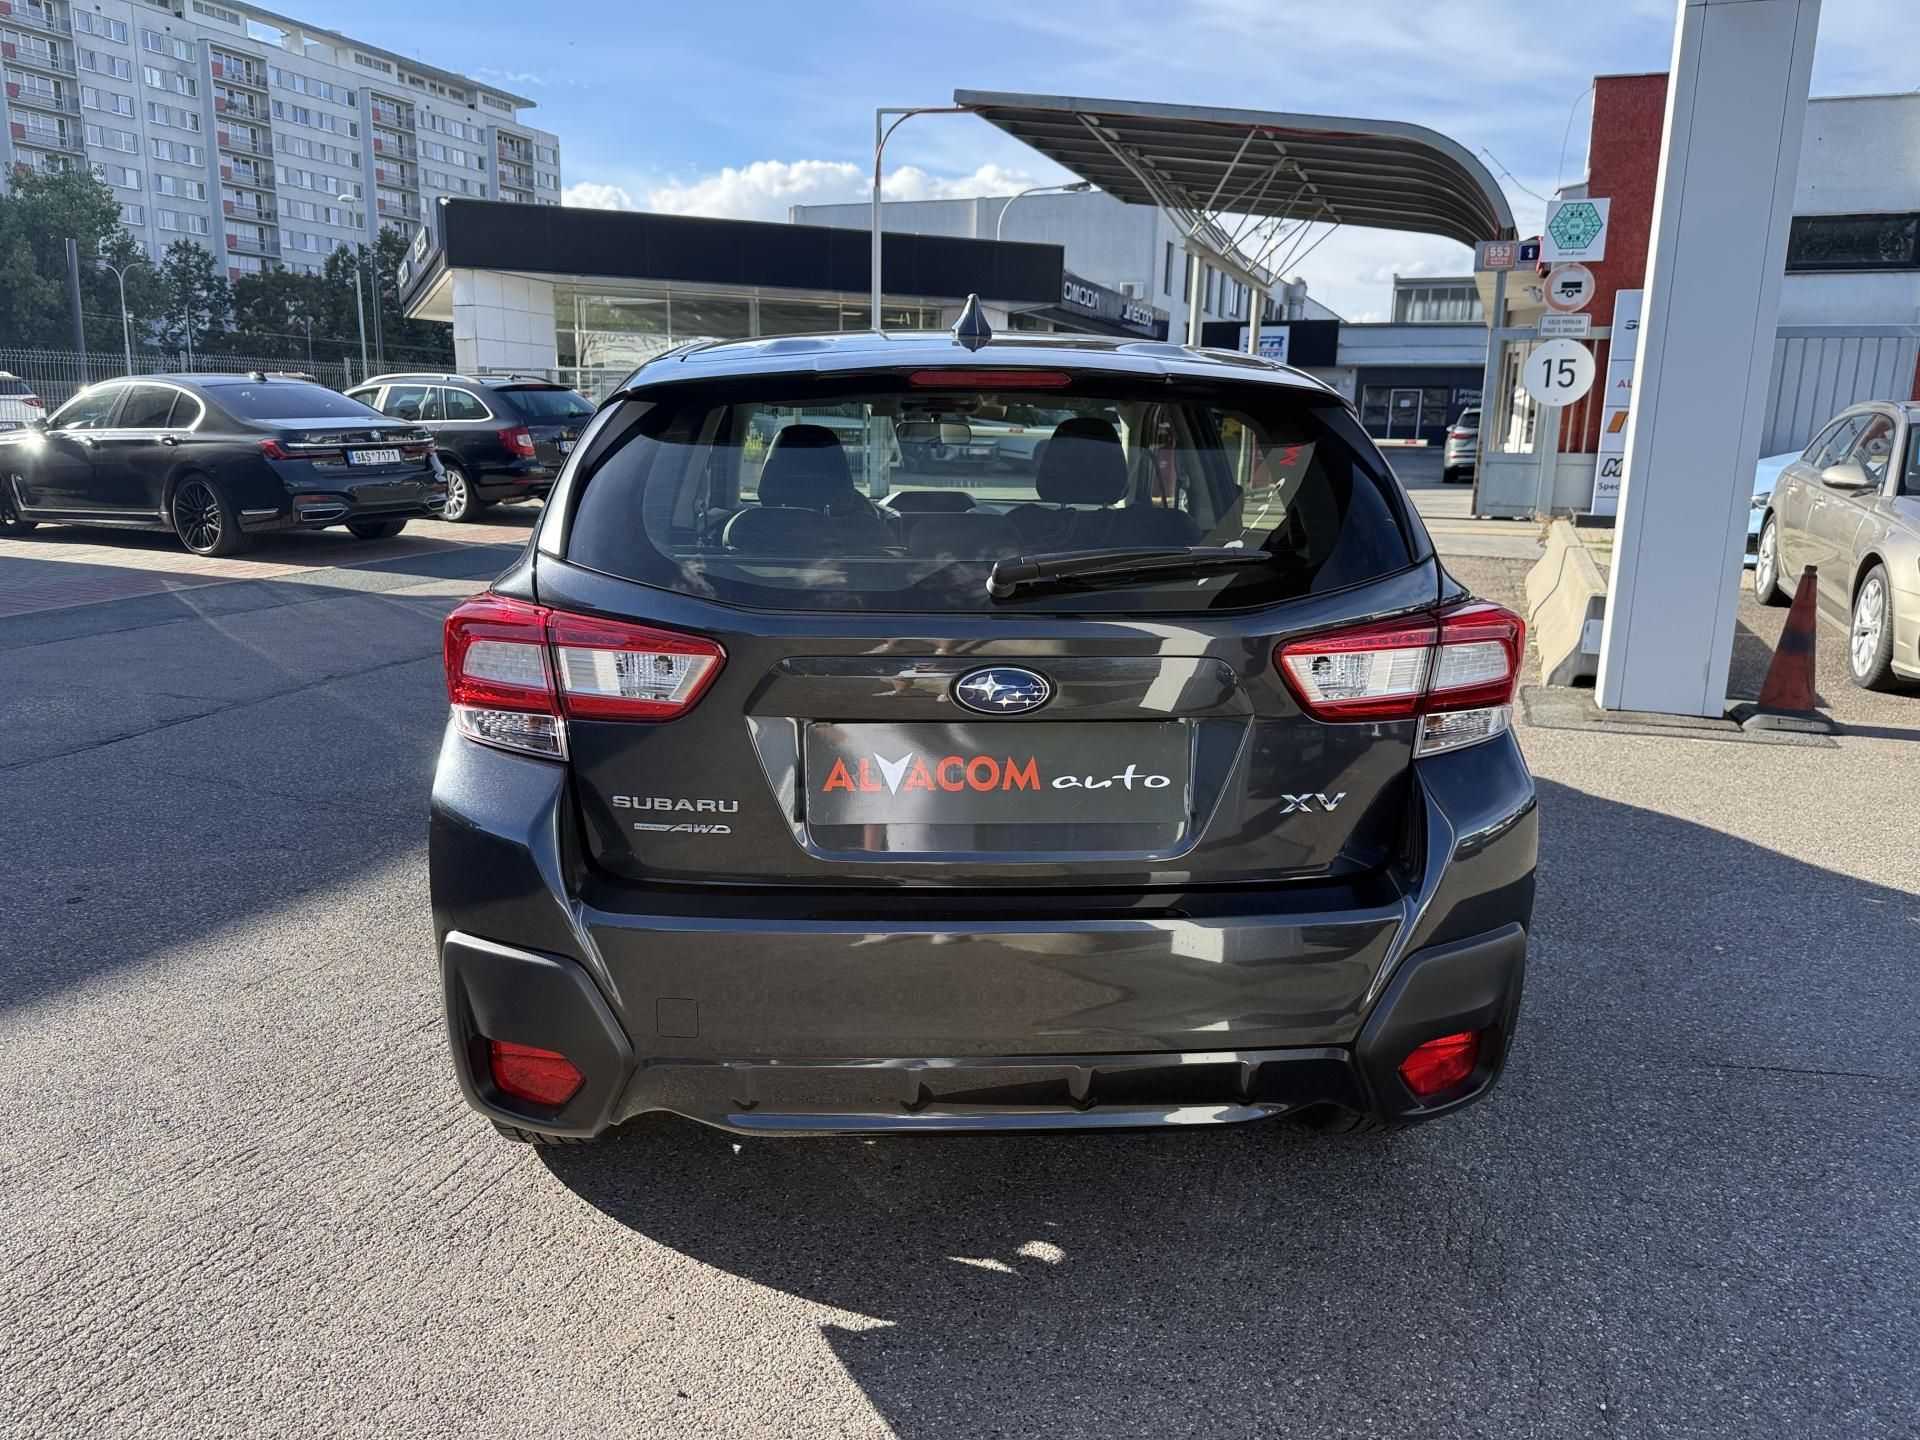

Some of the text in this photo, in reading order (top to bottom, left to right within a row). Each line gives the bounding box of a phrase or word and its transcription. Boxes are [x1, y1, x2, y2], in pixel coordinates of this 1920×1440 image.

[1489, 246, 1511, 257] 553
[1527, 247, 1534, 259] 1
[1542, 358, 1577, 388] 15
[375, 451, 396, 461] 7171
[822, 751, 1171, 795] ALVACOM auto
[611, 795, 739, 813] SUBARU
[1279, 791, 1347, 814] XV
[669, 823, 732, 834] AWD
